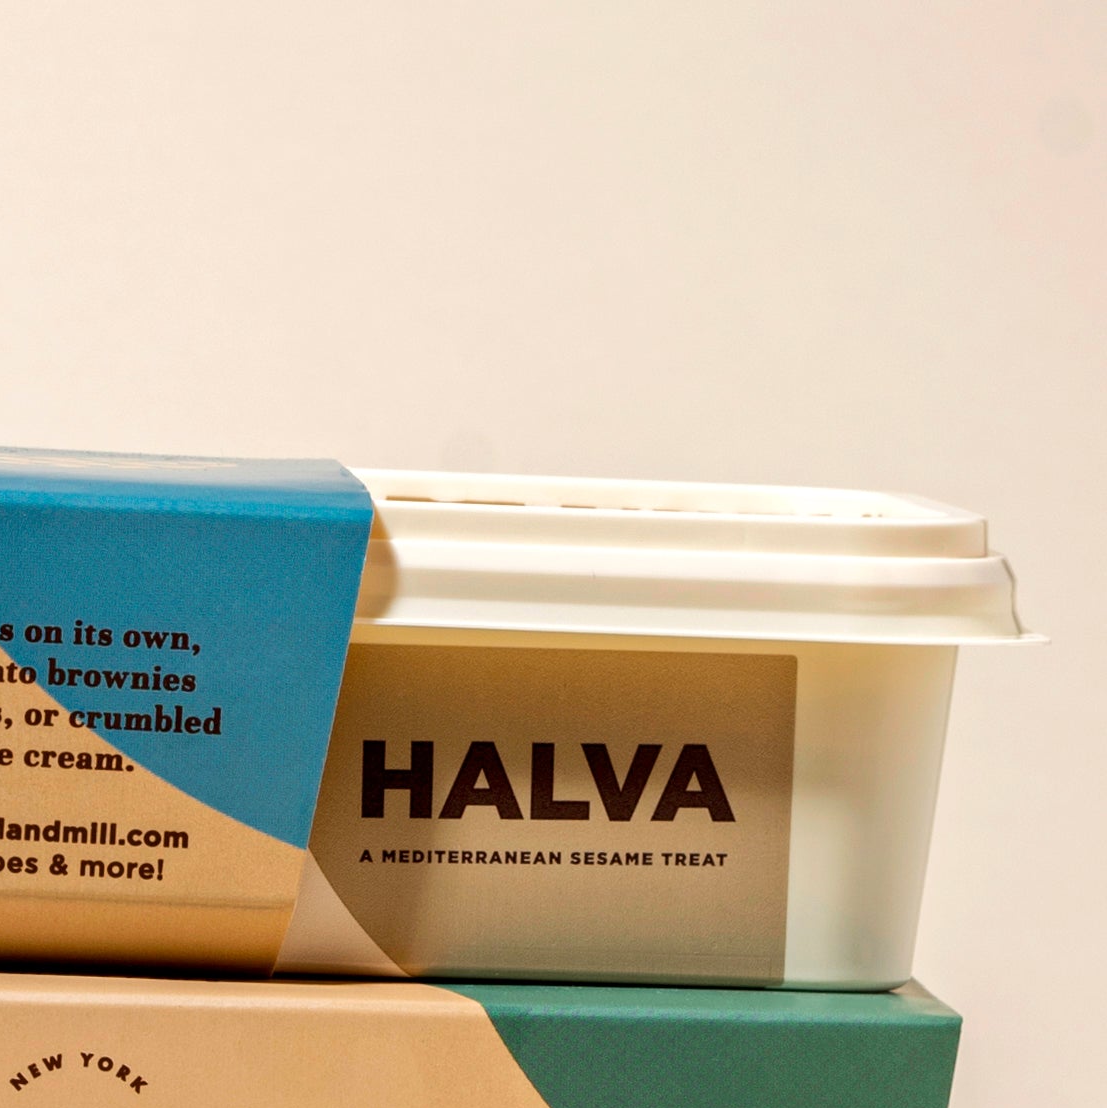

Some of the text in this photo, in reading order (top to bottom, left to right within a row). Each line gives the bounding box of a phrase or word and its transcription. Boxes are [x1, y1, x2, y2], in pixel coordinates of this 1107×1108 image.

[25, 625, 63, 644] on
[73, 620, 112, 646] its
[123, 630, 200, 656] own,
[48, 658, 196, 692] brownies
[25, 709, 59, 726] or
[70, 704, 221, 735] crumbled
[24, 749, 135, 772] cream.
[361, 740, 735, 821] HALVA
[49, 854, 68, 875] &
[80, 859, 163, 880] more!
[360, 849, 727, 866] A MEDITERRANEAN SESAME TREAT
[10, 1053, 148, 1094] NEW YORK
